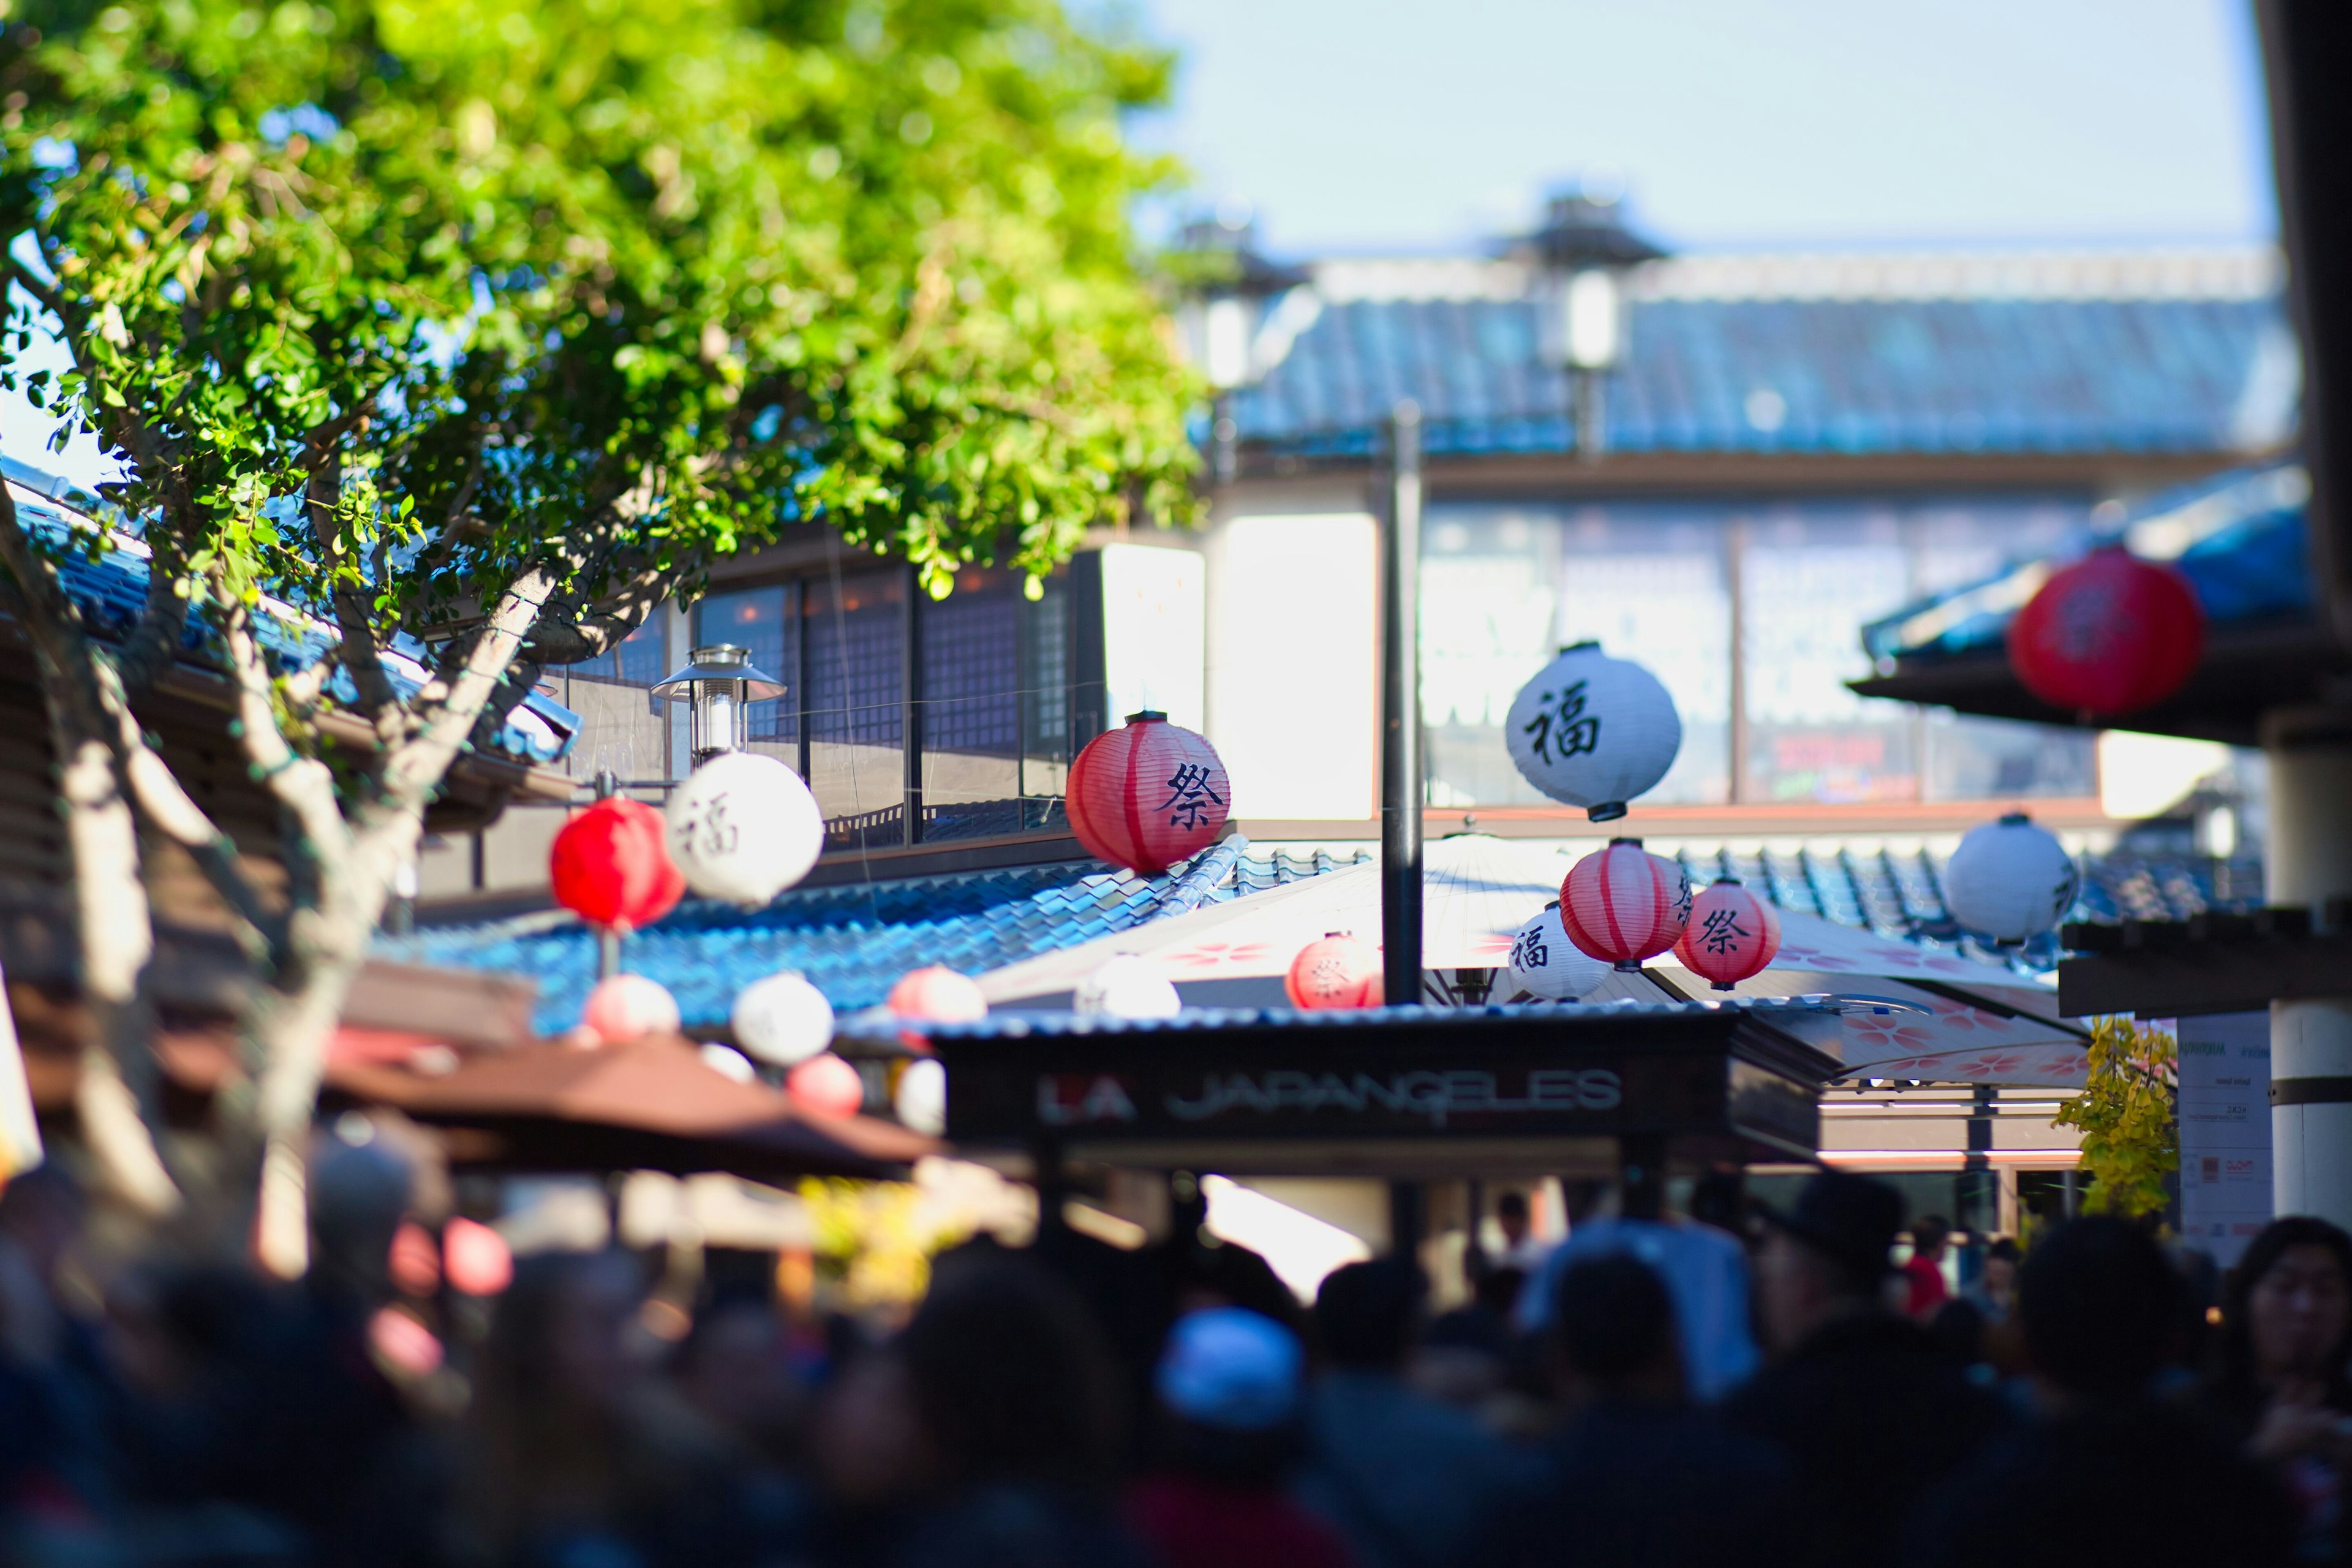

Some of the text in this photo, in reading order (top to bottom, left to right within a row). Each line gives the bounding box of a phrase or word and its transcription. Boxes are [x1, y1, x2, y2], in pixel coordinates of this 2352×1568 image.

[1525, 678, 1600, 766] 福
[1153, 763, 1224, 831] 祭
[676, 791, 738, 866] 福
[1511, 925, 1548, 973] 福
[1696, 909, 1751, 956] 祭
[1035, 1074, 1138, 1124] LA
